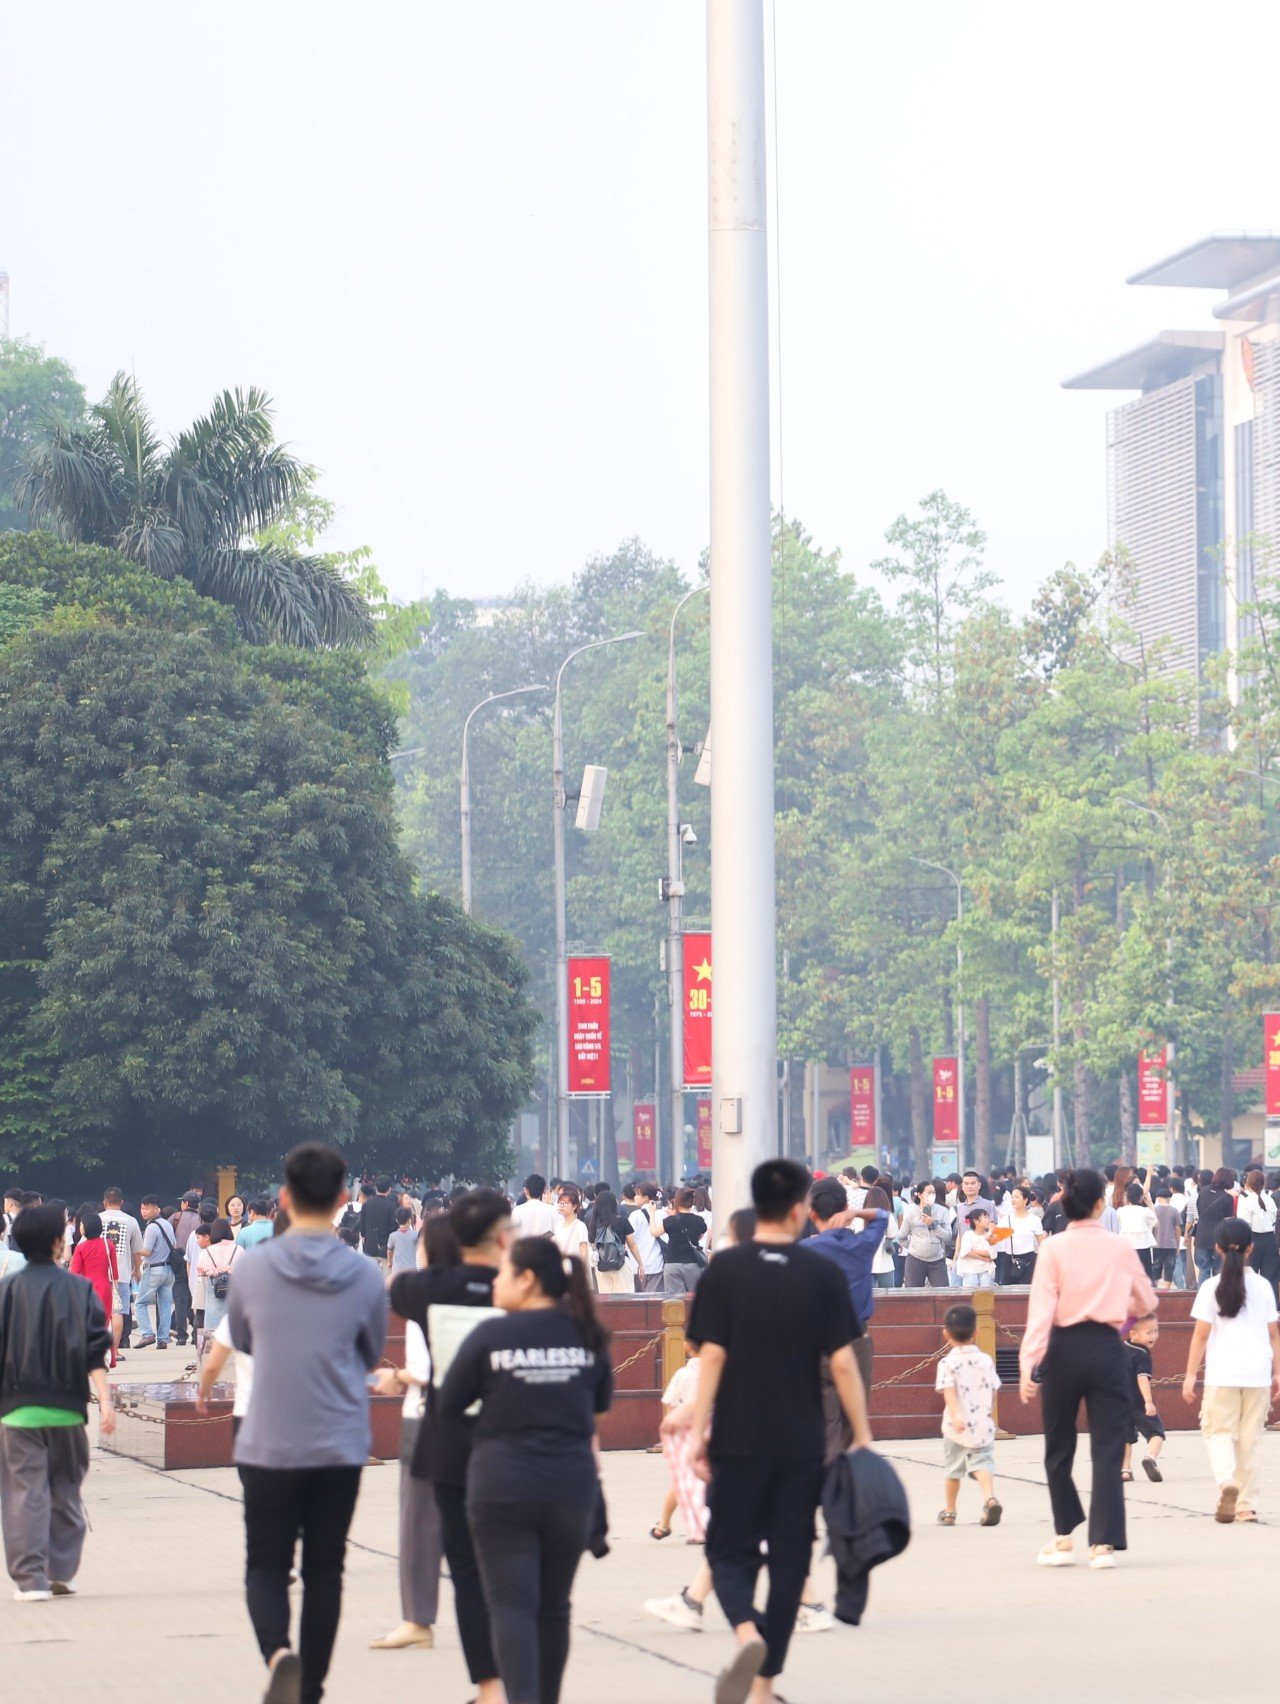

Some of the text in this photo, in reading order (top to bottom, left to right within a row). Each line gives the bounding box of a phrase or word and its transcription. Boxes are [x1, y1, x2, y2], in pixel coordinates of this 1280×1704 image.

[573, 976, 602, 998] 1-5
[689, 988, 711, 1010] 30-
[936, 1085, 954, 1099] 1-5
